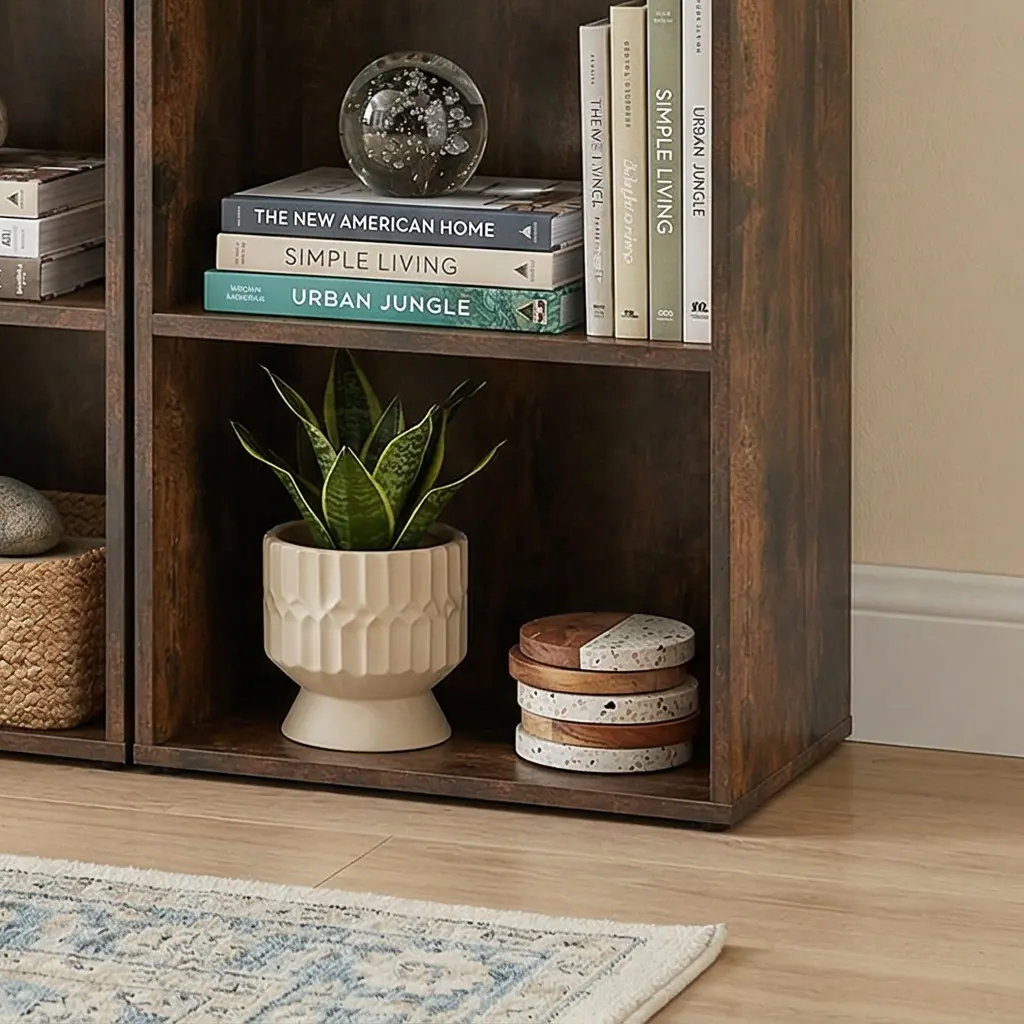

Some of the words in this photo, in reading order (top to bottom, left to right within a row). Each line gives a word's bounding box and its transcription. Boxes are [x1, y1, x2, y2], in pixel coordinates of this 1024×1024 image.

[655, 89, 673, 161] SIMPLE
[656, 171, 674, 235] LIVING
[693, 163, 705, 217] JUNGLE
[254, 208, 288, 226] THE
[294, 210, 335, 228] NEW
[340, 213, 435, 234] AMERICAN
[441, 219, 495, 237] HOME
[285, 247, 369, 270] SIMPLE
[379, 253, 457, 275] LIVING
[292, 288, 371, 308] URBAN
[381, 293, 470, 316] JUNGLE
